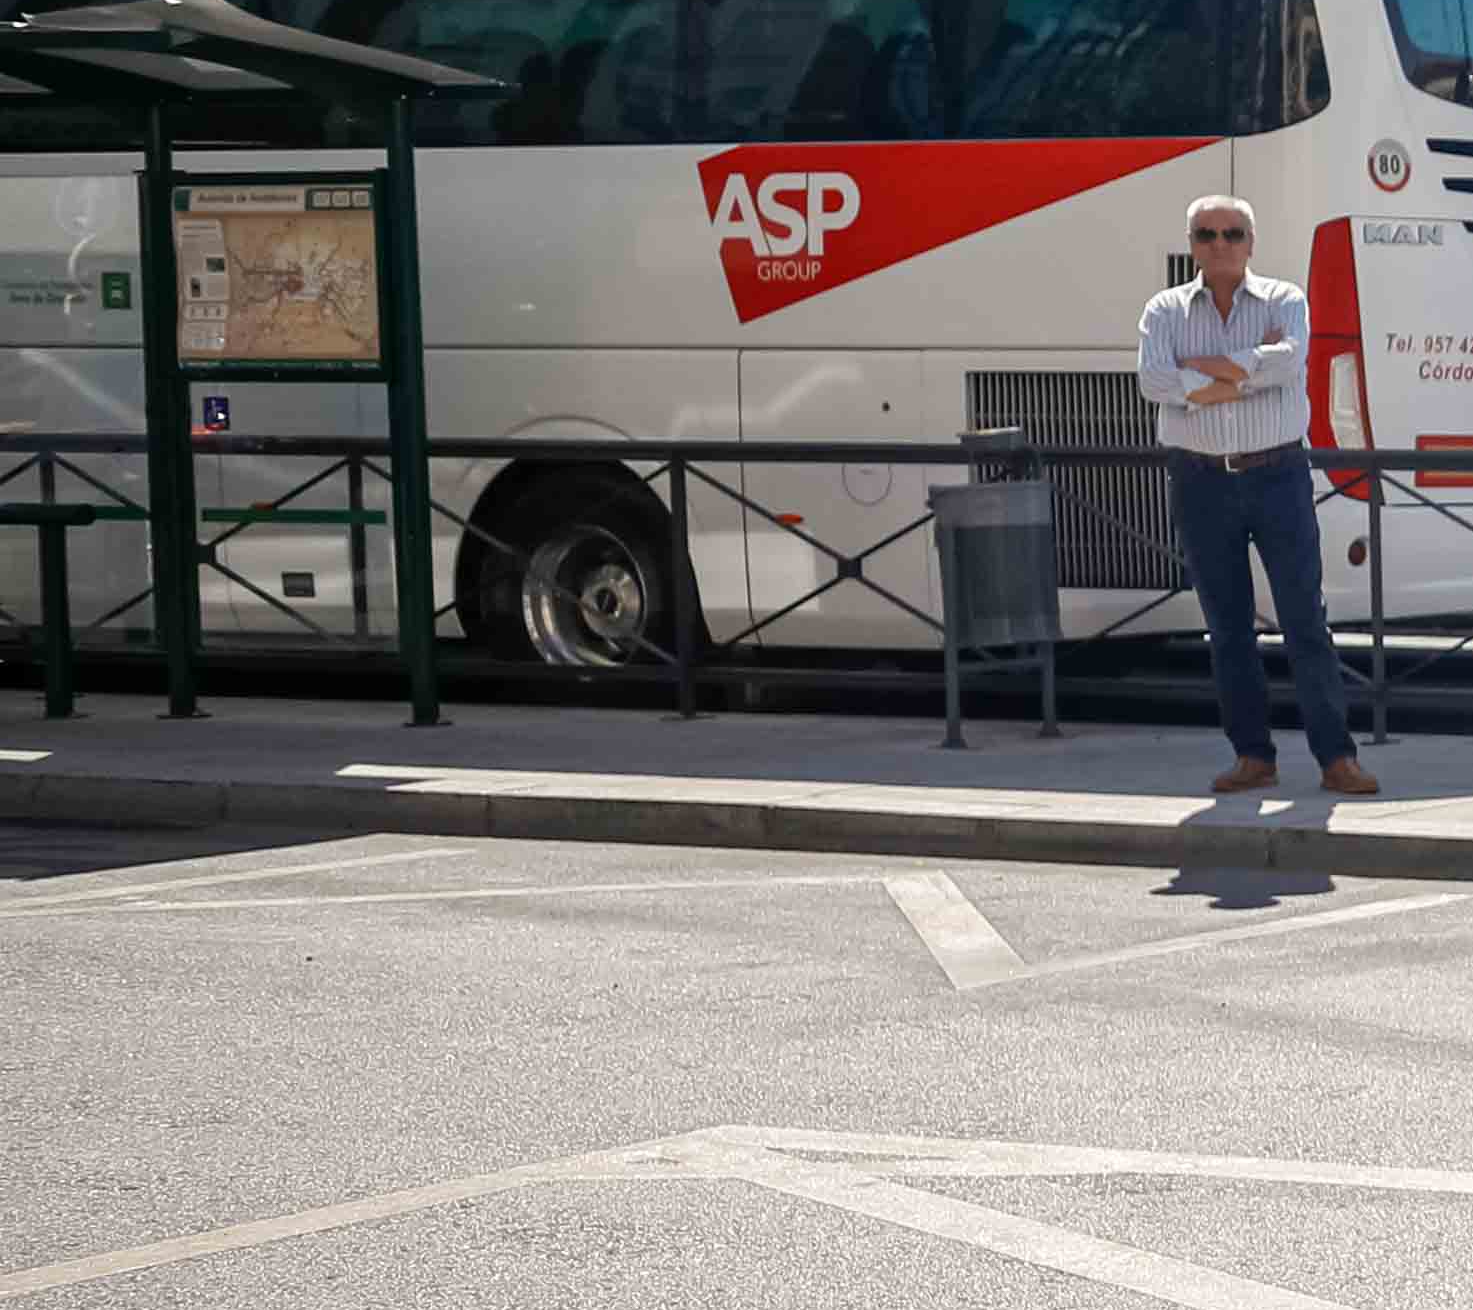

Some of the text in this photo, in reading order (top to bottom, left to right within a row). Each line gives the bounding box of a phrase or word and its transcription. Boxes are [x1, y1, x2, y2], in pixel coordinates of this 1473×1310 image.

[1379, 154, 1400, 175] 80
[710, 172, 861, 257] ASP
[1362, 223, 1443, 245] MAN
[758, 260, 822, 282] GROUP
[1424, 335, 1453, 353] 957
